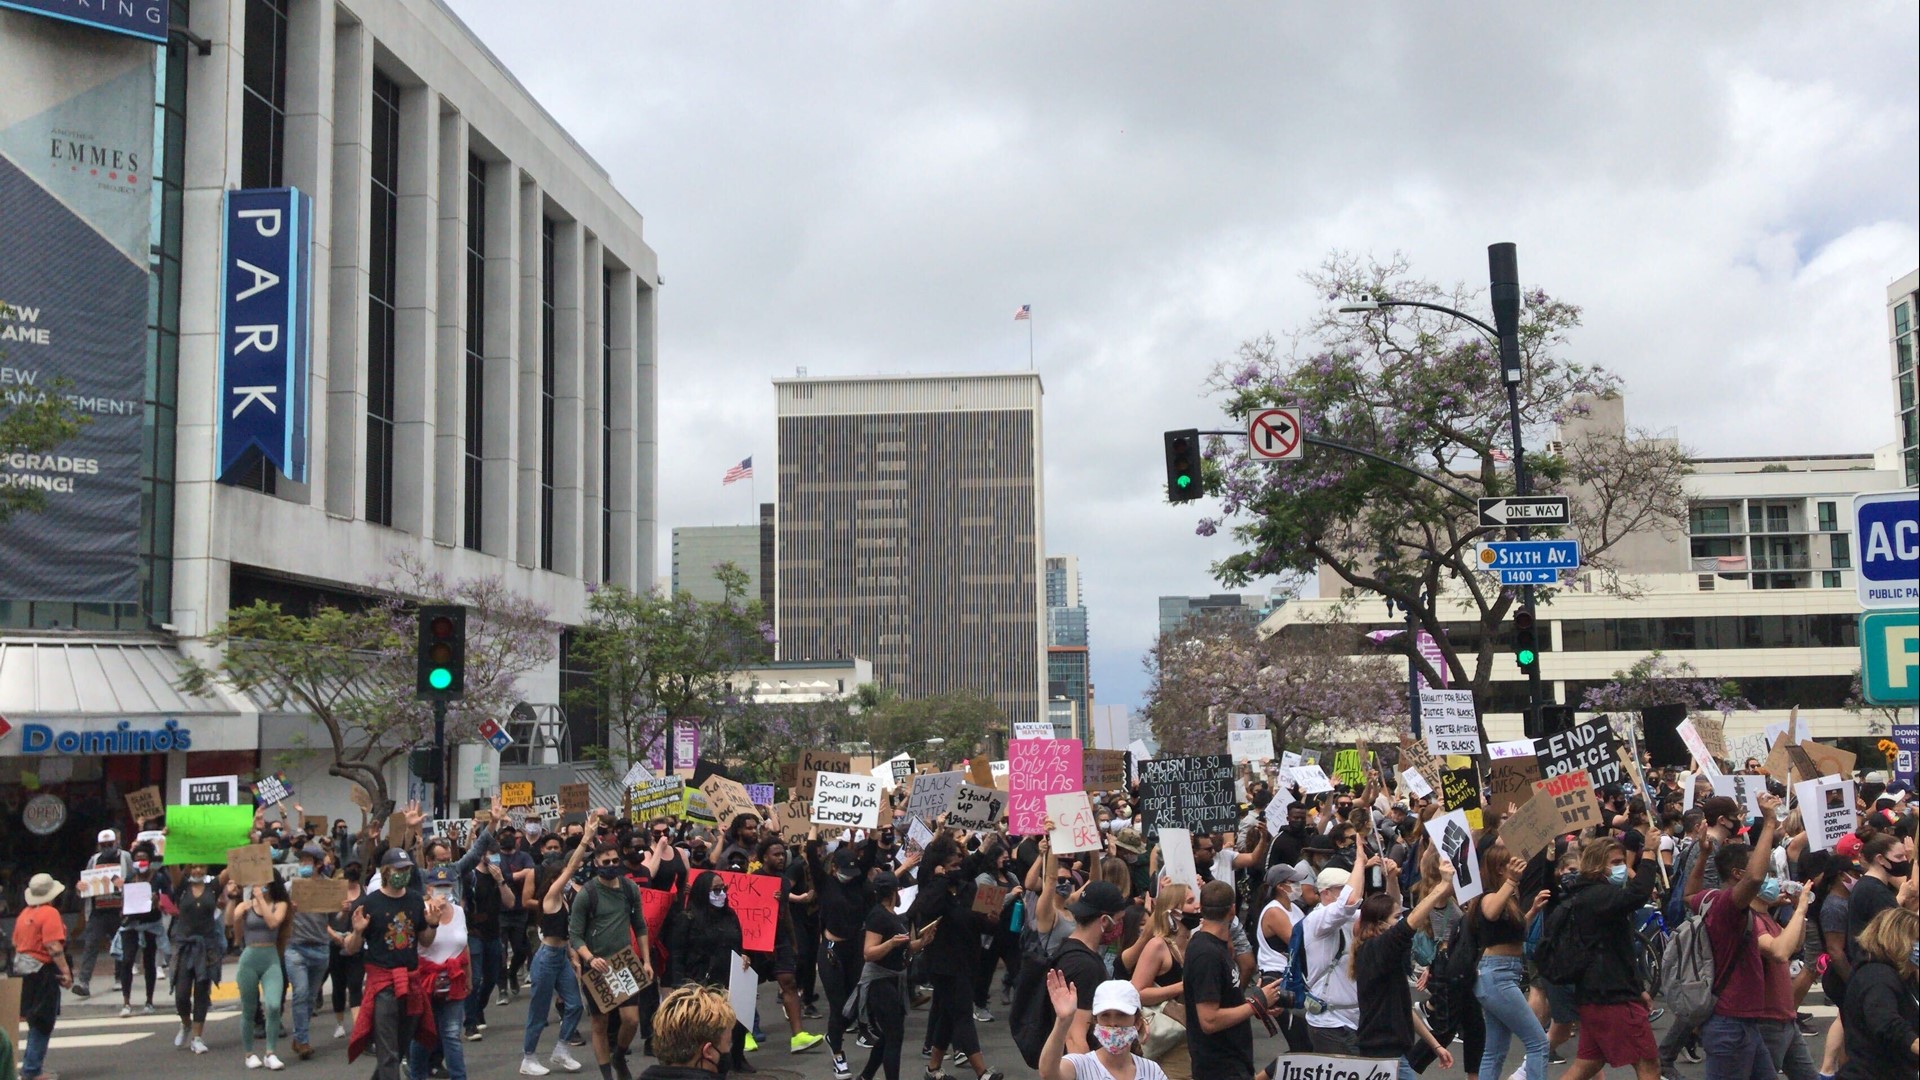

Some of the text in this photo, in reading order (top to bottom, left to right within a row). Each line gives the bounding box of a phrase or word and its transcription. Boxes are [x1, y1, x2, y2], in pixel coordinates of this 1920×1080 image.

[51, 138, 139, 172] EMMES
[232, 208, 281, 419] PARK
[4, 390, 137, 415] ANAEMENT
[1506, 505, 1560, 517] ONE WAY
[1507, 571, 1533, 582] 1400
[1869, 588, 1903, 600] PUBLIC
[1444, 693, 1455, 702] FOR
[1446, 707, 1456, 716] FOR
[22, 719, 193, 754] Domino's
[1428, 725, 1433, 733] A
[1010, 739, 1071, 756] We Are
[1437, 740, 1475, 753] FOR BLACKS
[1703, 742, 1721, 753] ATTER
[1726, 733, 1764, 752] BLACK
[1900, 737, 1917, 745] THE
[1012, 756, 1045, 774] Only
[1046, 756, 1069, 772] As
[1146, 755, 1220, 773] RACISM IS SO
[819, 774, 861, 789] Racism
[1010, 772, 1075, 791] Blind As
[1140, 767, 1234, 784] AMERICAN THAT WHEN
[1546, 771, 1589, 797] USTICE
[192, 784, 218, 793] BLACK
[913, 776, 951, 795] BLACK
[1151, 784, 1172, 797] YOU
[195, 793, 221, 801] LIVES
[818, 791, 849, 804] Small
[852, 794, 877, 808] Dick
[910, 793, 945, 808] LIVES
[958, 788, 992, 802] Stand
[1012, 794, 1041, 811] We
[1144, 791, 1233, 810] PEOPLE THINK YOU
[1555, 789, 1587, 809] AN'T
[27, 803, 64, 820] OPEN
[817, 805, 863, 825] Energy
[1155, 804, 1237, 823] ARE PROTESTING
[1560, 805, 1591, 825] AIT
[1823, 808, 1851, 819] JUSTICE
[1824, 818, 1838, 827] FOR
[1824, 822, 1852, 833] GEORGE
[727, 874, 762, 897] ACK
[736, 907, 773, 924] TTER
[618, 969, 636, 994] SMALL
